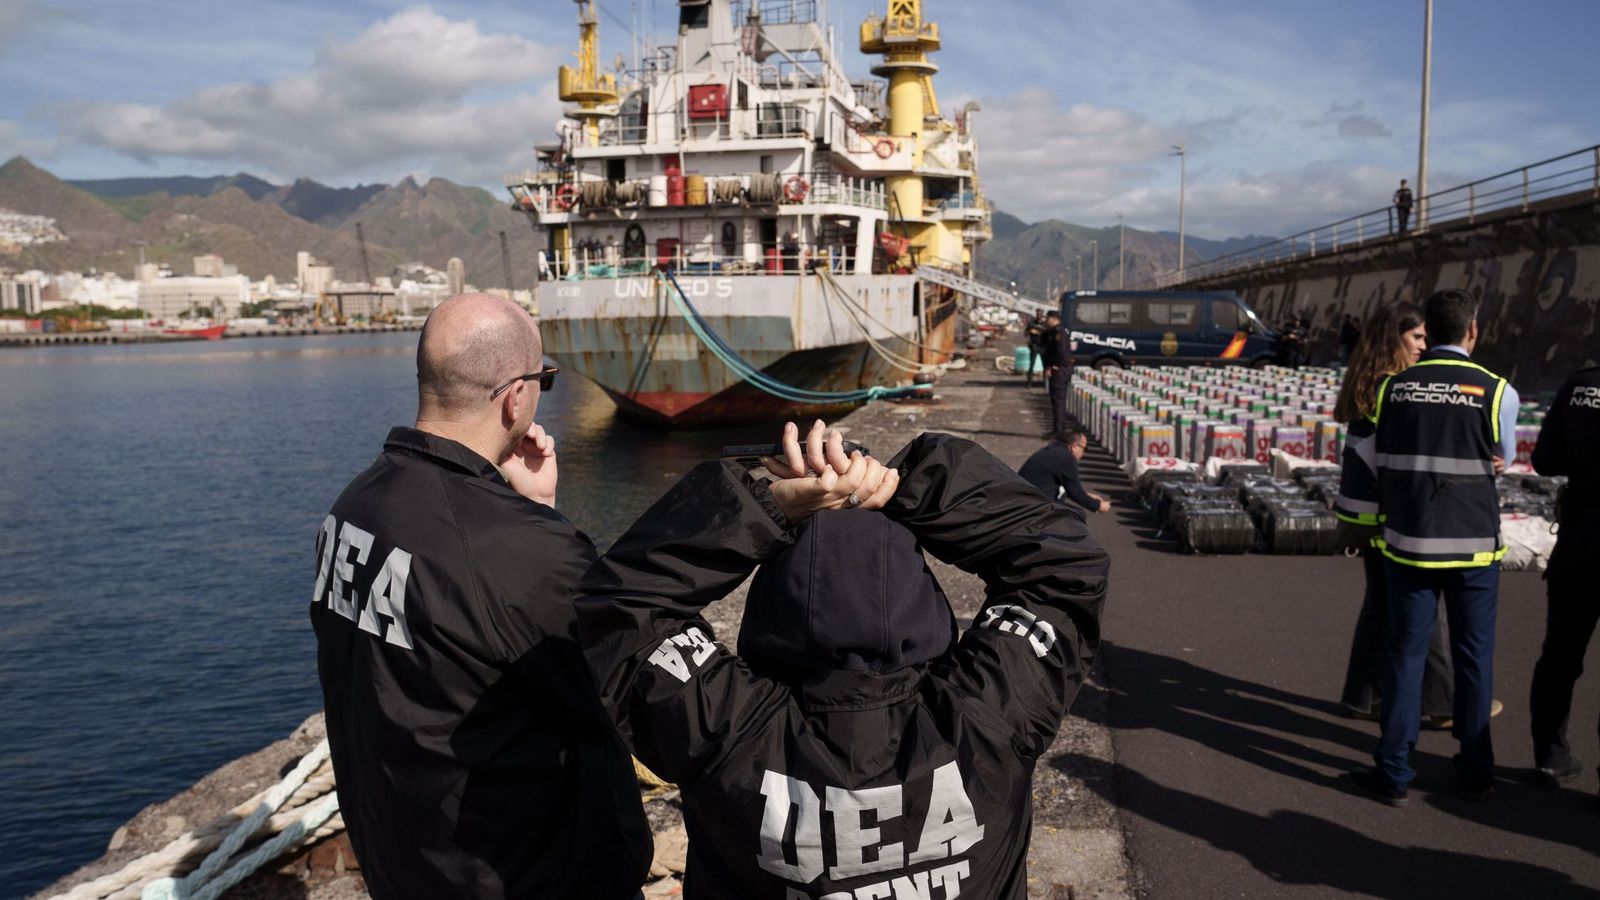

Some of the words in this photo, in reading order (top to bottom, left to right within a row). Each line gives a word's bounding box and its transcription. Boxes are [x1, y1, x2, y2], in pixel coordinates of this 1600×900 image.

[715, 278, 733, 298] S
[1392, 381, 1461, 393] POLICIA
[1572, 386, 1600, 398] PO
[1390, 392, 1482, 408] NACIONAL
[313, 514, 414, 650] DEA
[756, 760, 985, 884] DEA
